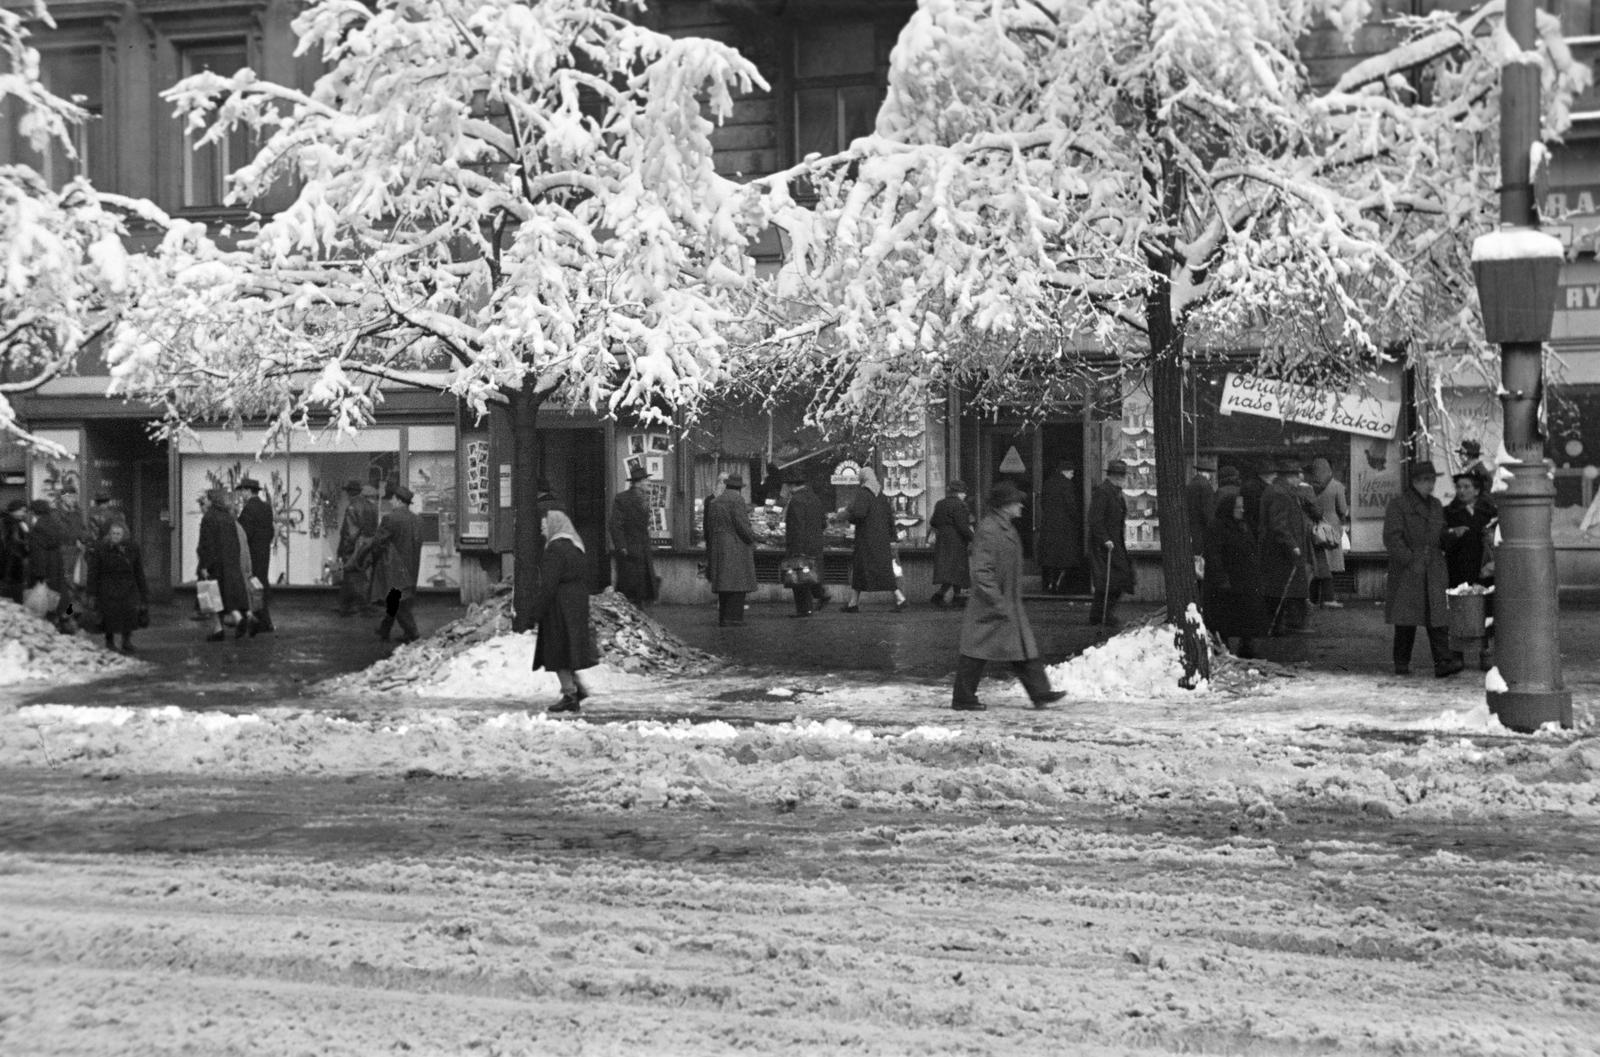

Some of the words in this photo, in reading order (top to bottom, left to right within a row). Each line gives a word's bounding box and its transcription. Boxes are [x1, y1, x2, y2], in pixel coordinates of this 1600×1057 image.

[1228, 393, 1272, 411] naše
[1279, 399, 1327, 421] tplé
[1331, 407, 1392, 434] kakao
